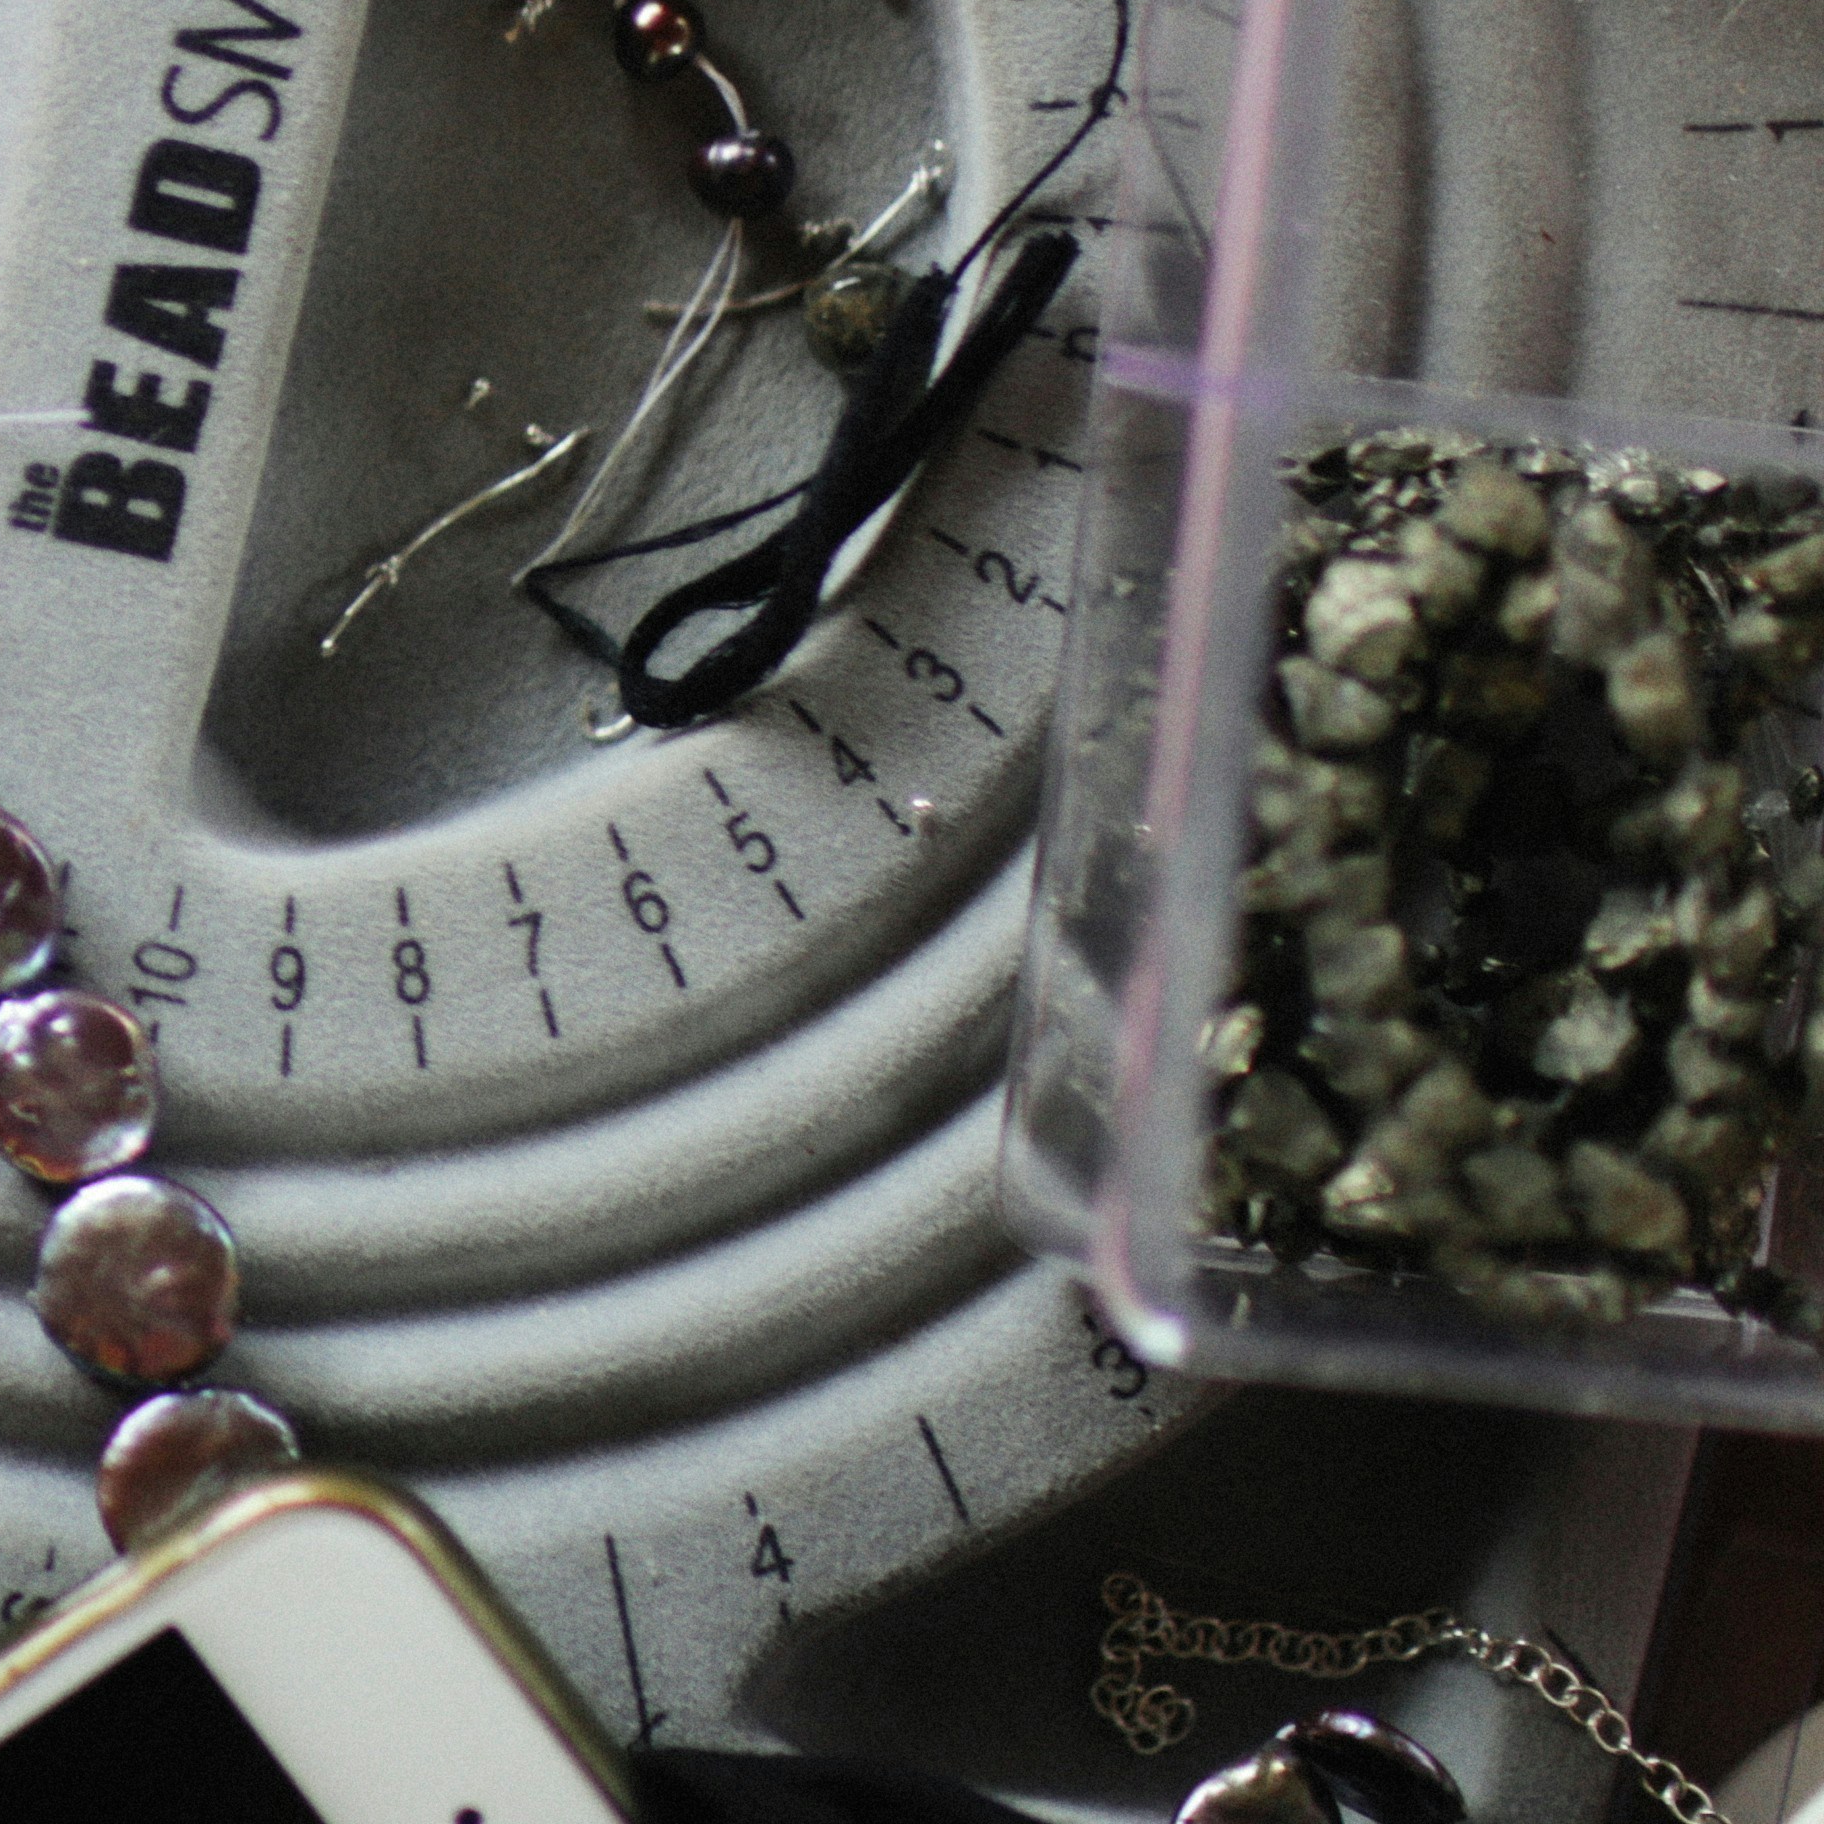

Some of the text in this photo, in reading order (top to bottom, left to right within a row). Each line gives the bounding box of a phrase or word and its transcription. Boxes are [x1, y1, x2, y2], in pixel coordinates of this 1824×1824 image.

[7, 460, 60, 534] the
[974, 548, 1042, 606] 2
[903, 644, 965, 705] 3
[828, 734, 878, 790] 4
[723, 810, 779, 876] 5
[620, 868, 672, 936] 6
[128, 940, 197, 1008] 10
[391, 937, 433, 1008] 8
[506, 909, 545, 978] 7
[268, 943, 308, 1013] 9
[1091, 1336, 1148, 1402] 3
[752, 1523, 796, 1584] 4
